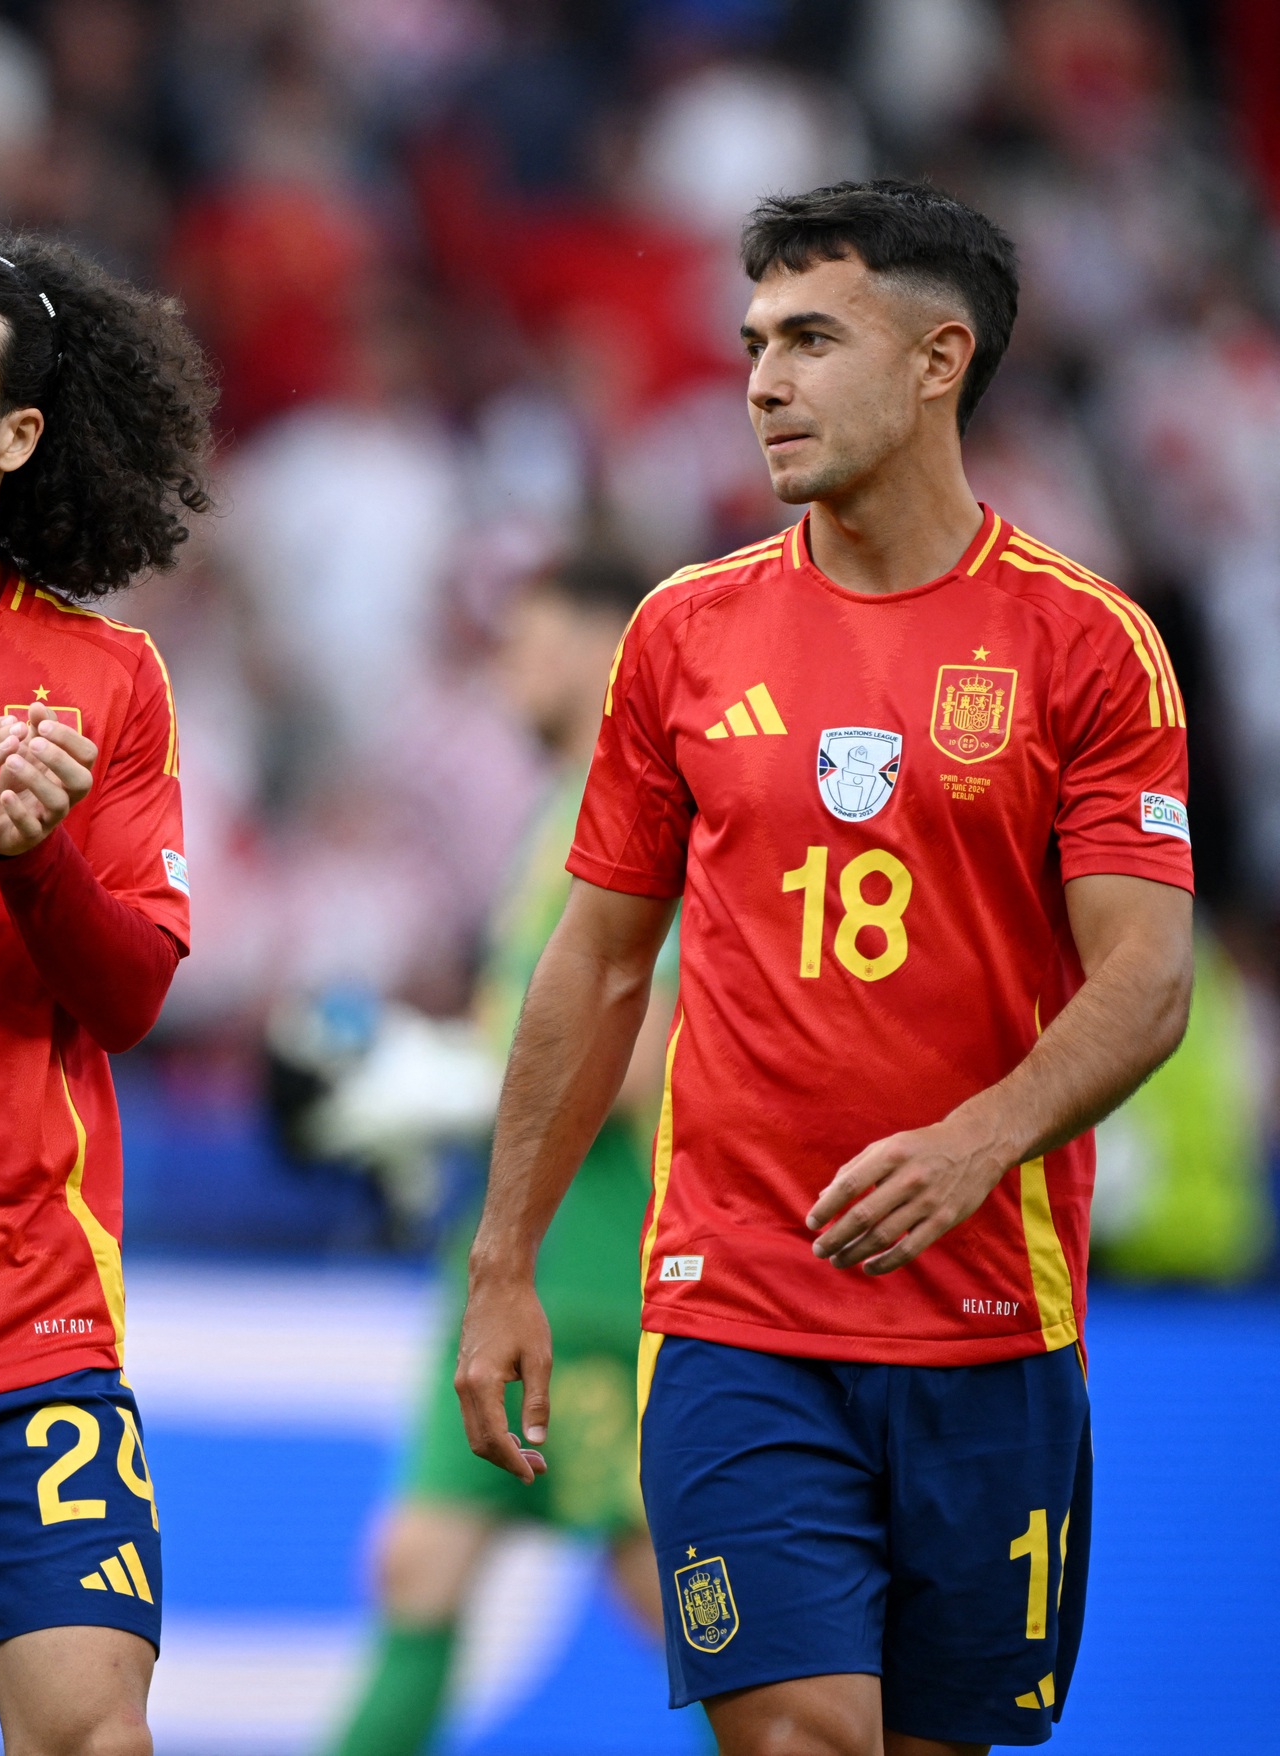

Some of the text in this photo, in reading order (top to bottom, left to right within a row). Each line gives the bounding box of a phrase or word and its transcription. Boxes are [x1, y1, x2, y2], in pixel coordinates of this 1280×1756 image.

[873, 732, 899, 742] LEAGUE
[940, 774, 958, 783] SPAIN
[965, 776, 991, 787] CROATIA
[951, 783, 967, 792] JUNE
[968, 785, 985, 794] 2024
[952, 791, 975, 801] BERLIN
[1144, 795, 1165, 805] UEFA
[833, 805, 874, 818] WINNER 2023
[782, 846, 913, 983] 18
[963, 1298, 1020, 1316] HEAT.RDY
[34, 1319, 93, 1334] HEAT.RDY
[24, 1402, 160, 1533] 24
[1009, 1508, 1070, 1640] 1
